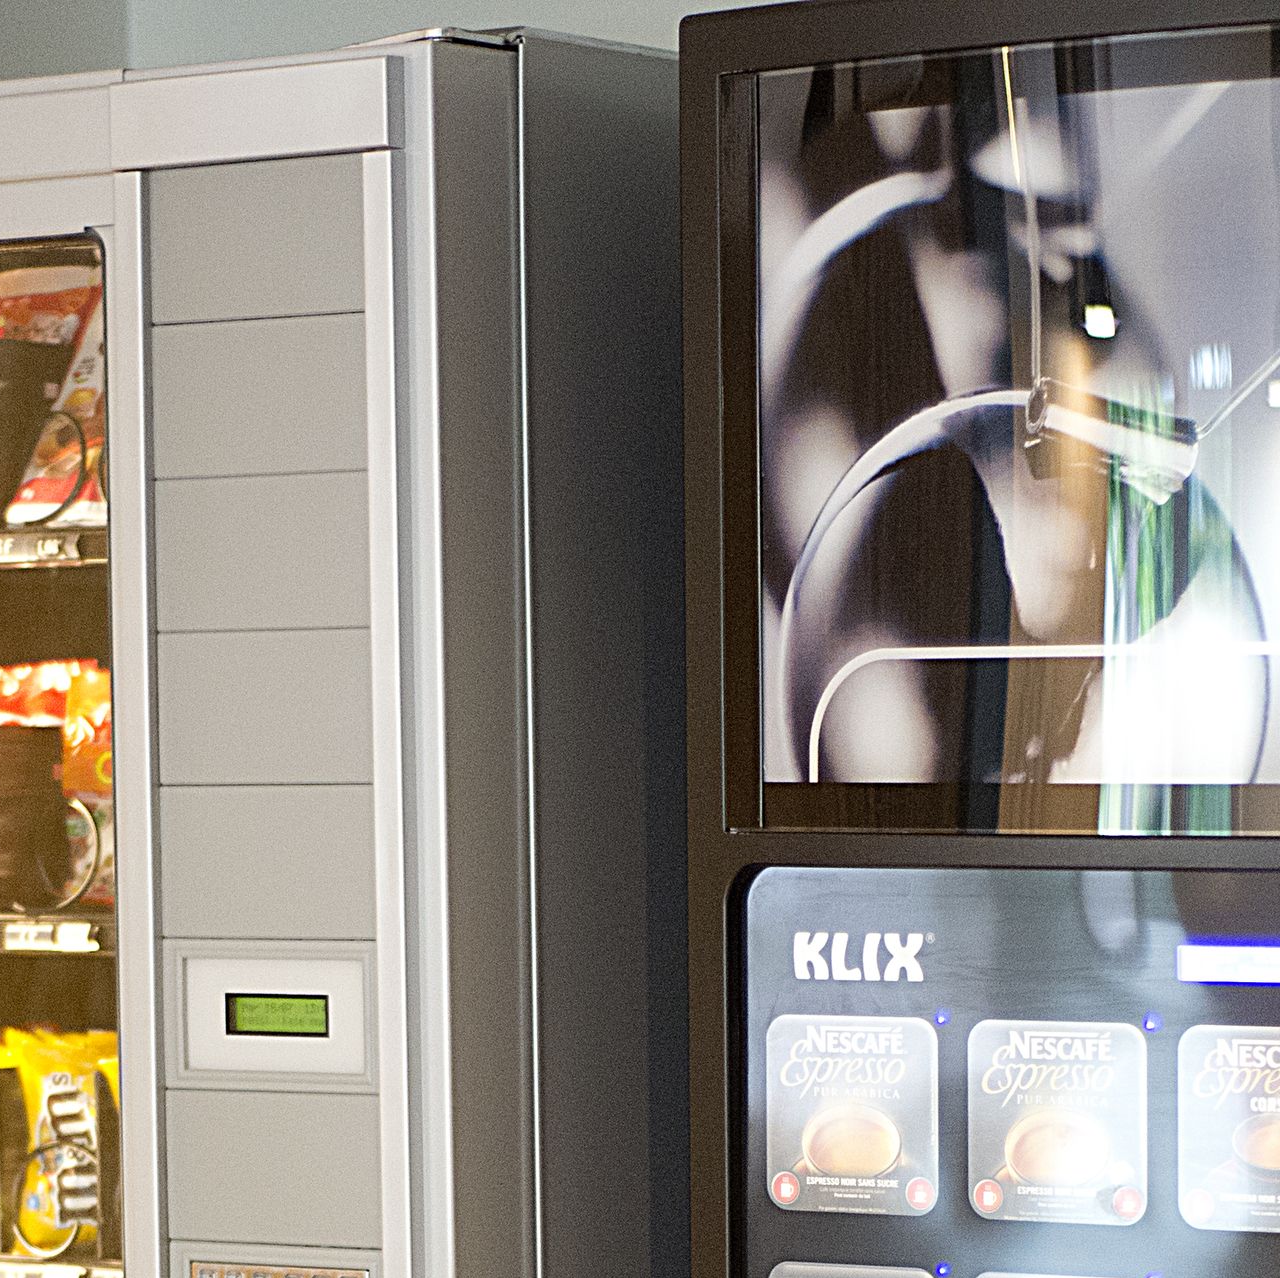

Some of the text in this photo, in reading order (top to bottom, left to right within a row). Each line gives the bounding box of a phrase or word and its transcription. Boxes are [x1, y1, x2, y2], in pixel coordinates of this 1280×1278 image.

[793, 932, 924, 982] KLIX
[806, 1025, 904, 1054] NESCAFÉ
[1009, 1031, 1112, 1061] NESCAFÉ
[780, 1040, 906, 1100] Espresso
[982, 1045, 1115, 1108] Espresso
[806, 1177, 839, 1186] ESPRESSO
